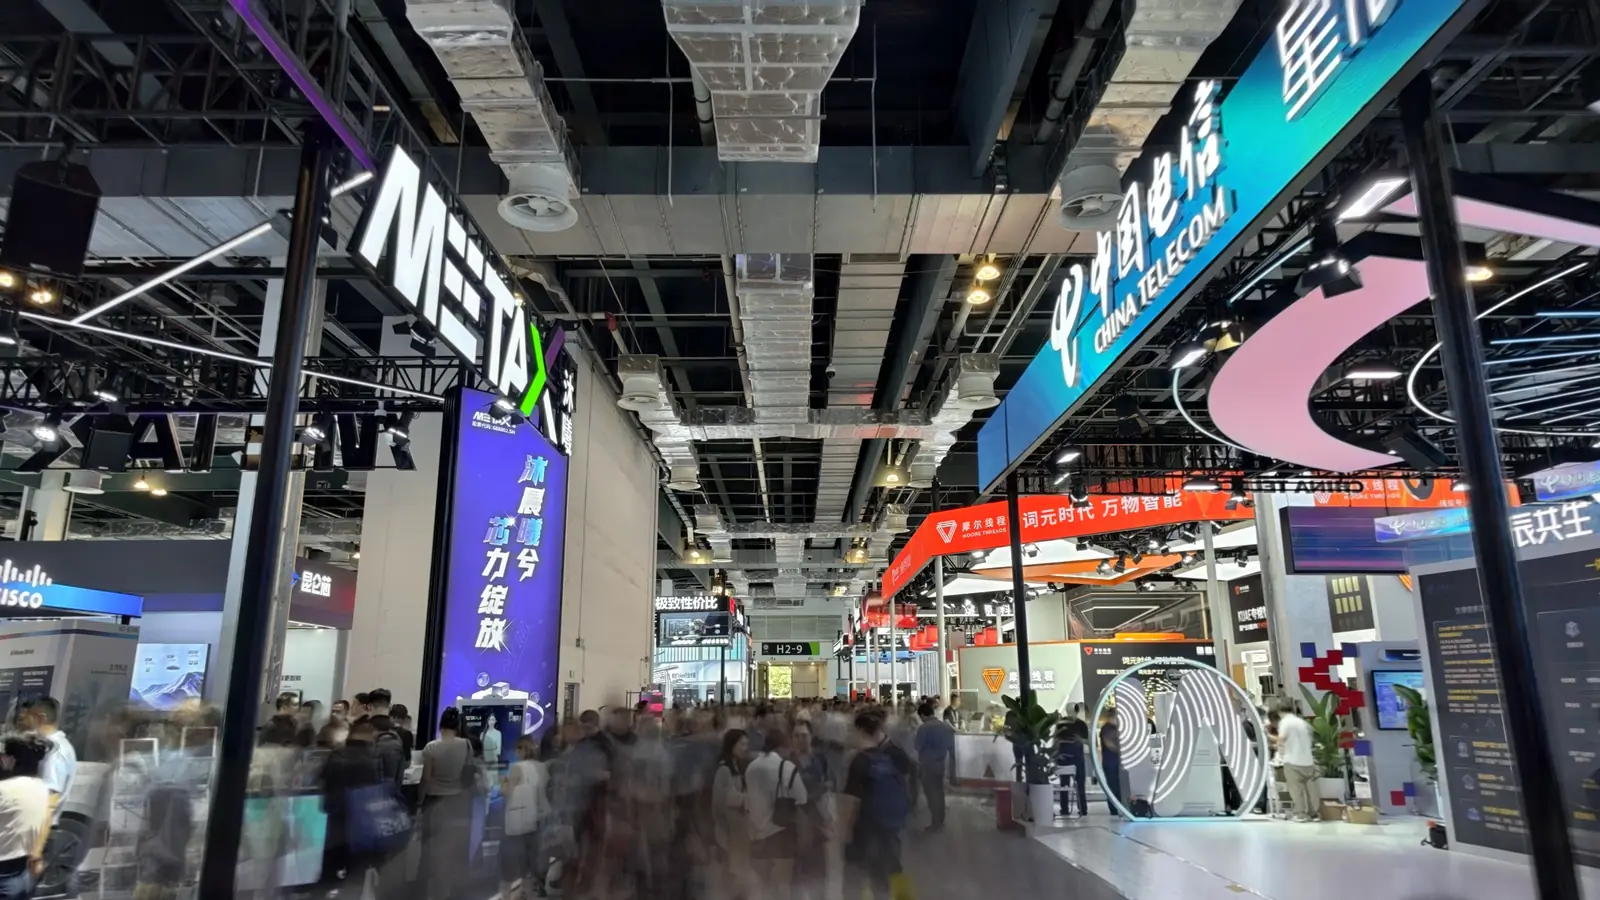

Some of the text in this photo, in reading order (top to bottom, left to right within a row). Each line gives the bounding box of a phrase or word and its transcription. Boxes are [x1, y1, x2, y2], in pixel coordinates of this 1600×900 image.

[1277, 0, 1399, 122] 星
[1091, 79, 1221, 317] 中国电信
[359, 144, 566, 444] METAX
[1094, 185, 1227, 354] CHINA TELECOM
[475, 516, 516, 652] 芯力绽放
[961, 515, 1007, 532] 摩尔线程
[655, 595, 718, 610] 极致性价比
[776, 644, 803, 654] H2-9
